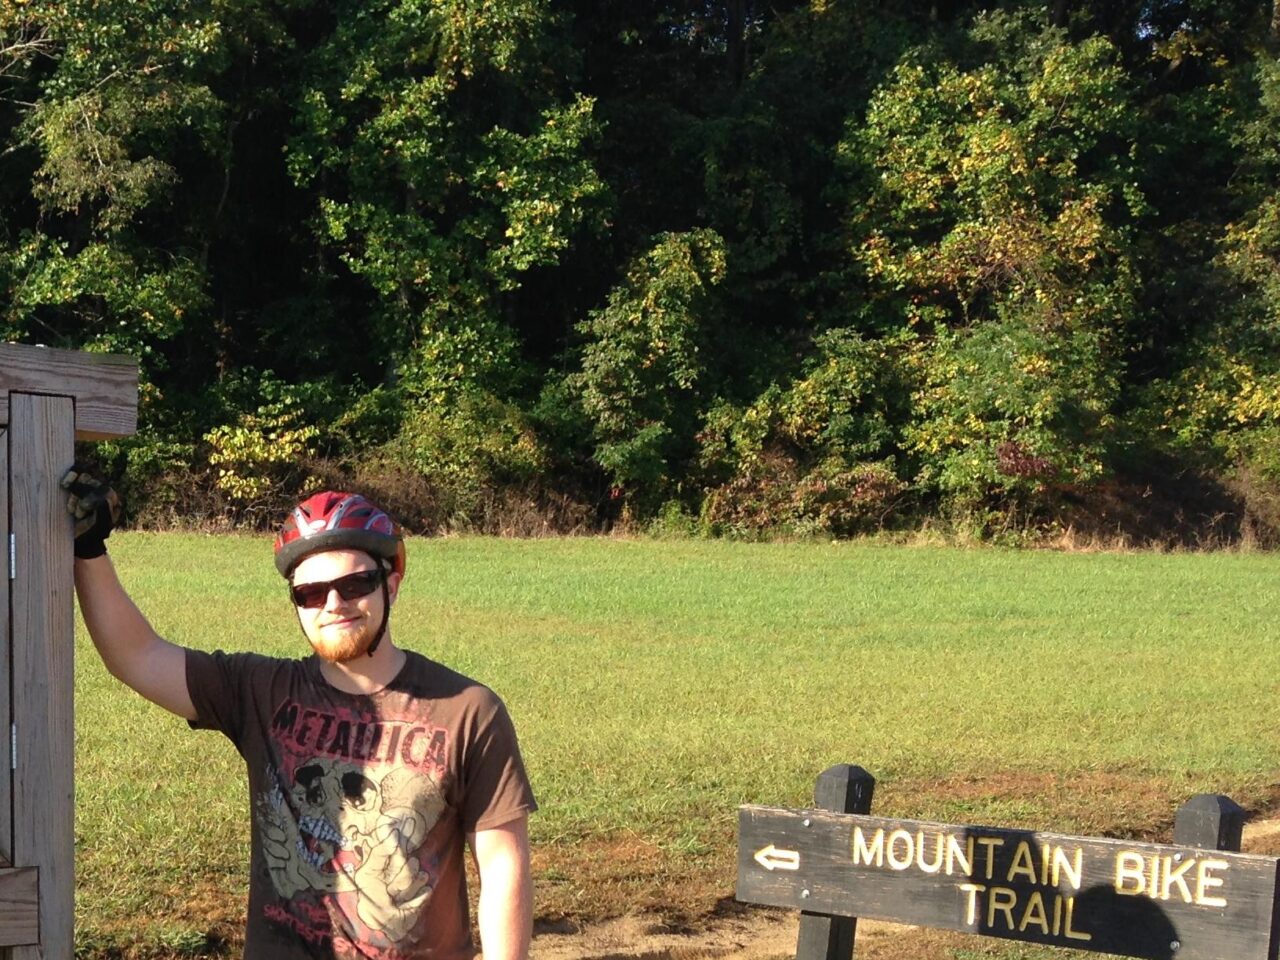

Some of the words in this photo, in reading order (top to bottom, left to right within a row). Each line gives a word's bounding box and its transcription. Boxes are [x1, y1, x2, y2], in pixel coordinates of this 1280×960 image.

[271, 700, 449, 770] METALLICA
[852, 826, 1083, 890] MOUNTAIN
[1115, 850, 1228, 907] BIKE
[960, 883, 1092, 942] TRAIL
